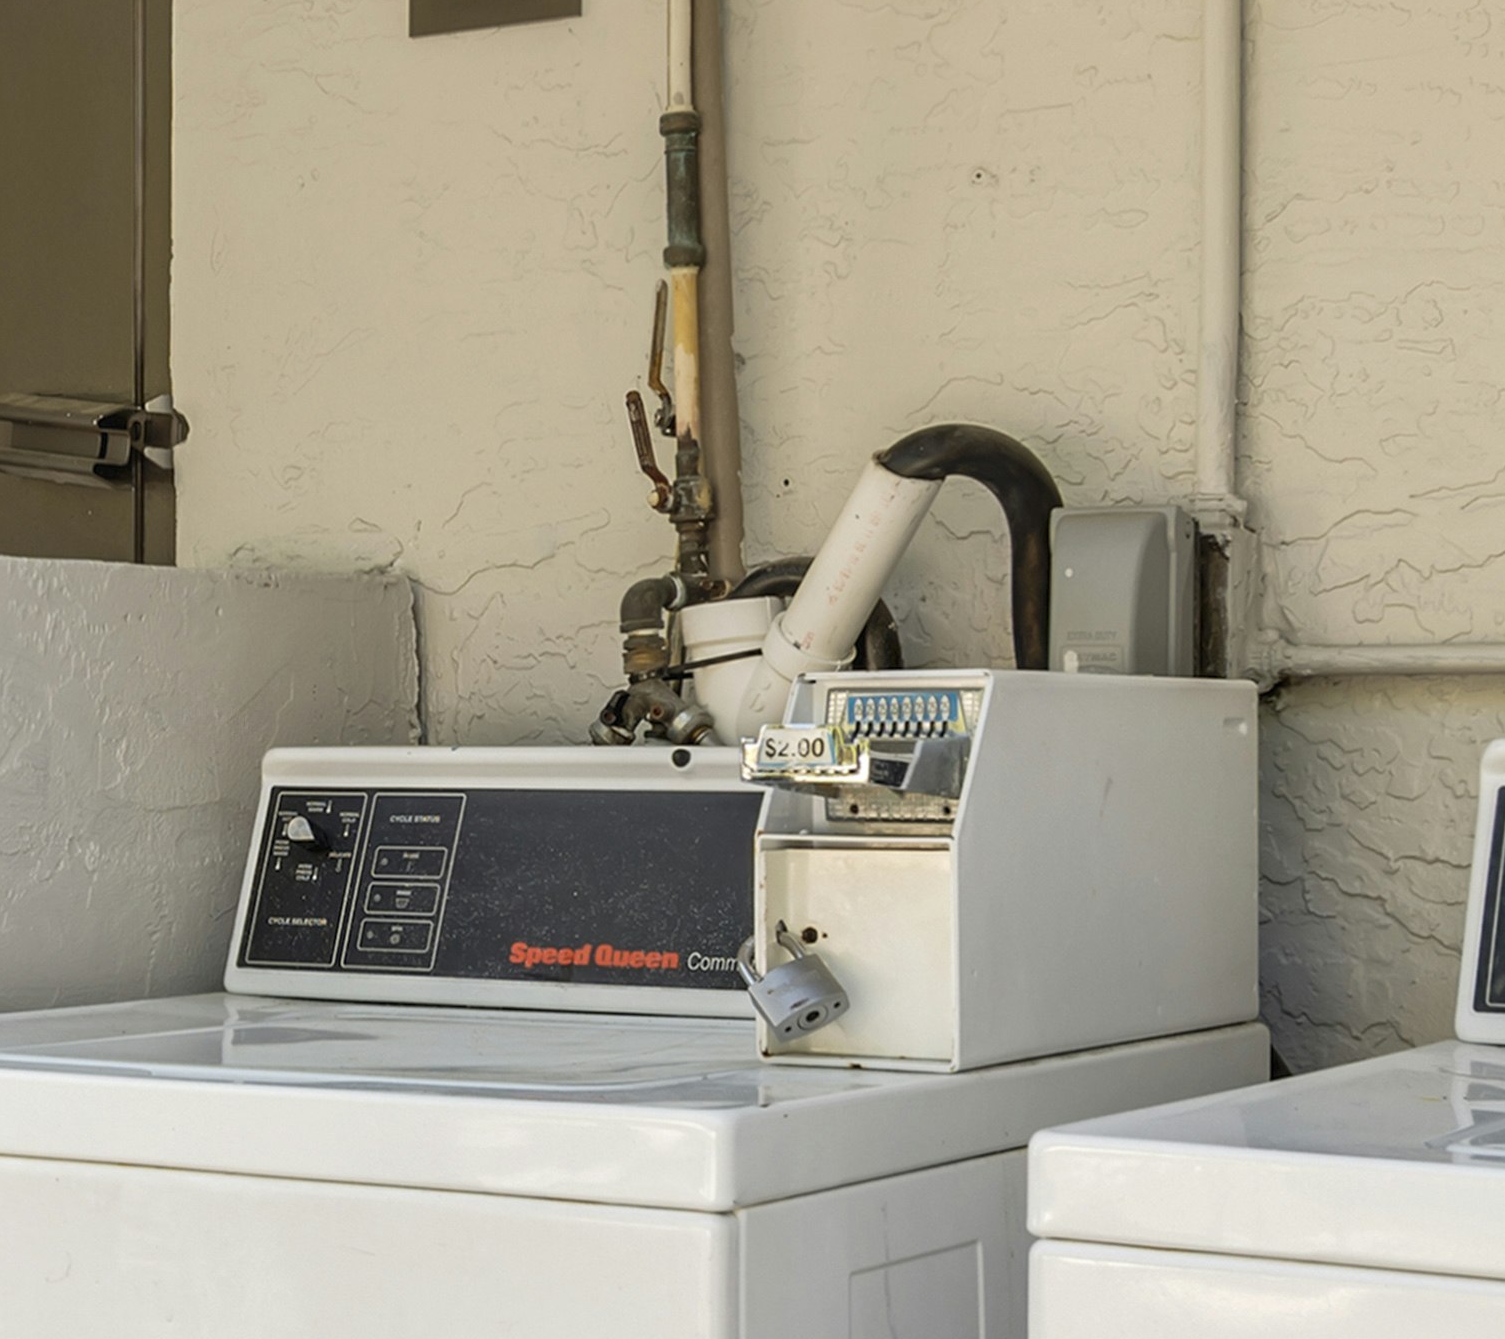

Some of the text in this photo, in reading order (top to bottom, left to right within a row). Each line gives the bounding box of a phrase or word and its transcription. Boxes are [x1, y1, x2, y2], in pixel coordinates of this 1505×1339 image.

[765, 737, 824, 759] $2.00
[389, 814, 441, 824] CYCLE STATUS
[268, 916, 328, 927] CYCLE SELECTOR
[509, 941, 592, 969] Speed
[595, 943, 680, 969] Queen
